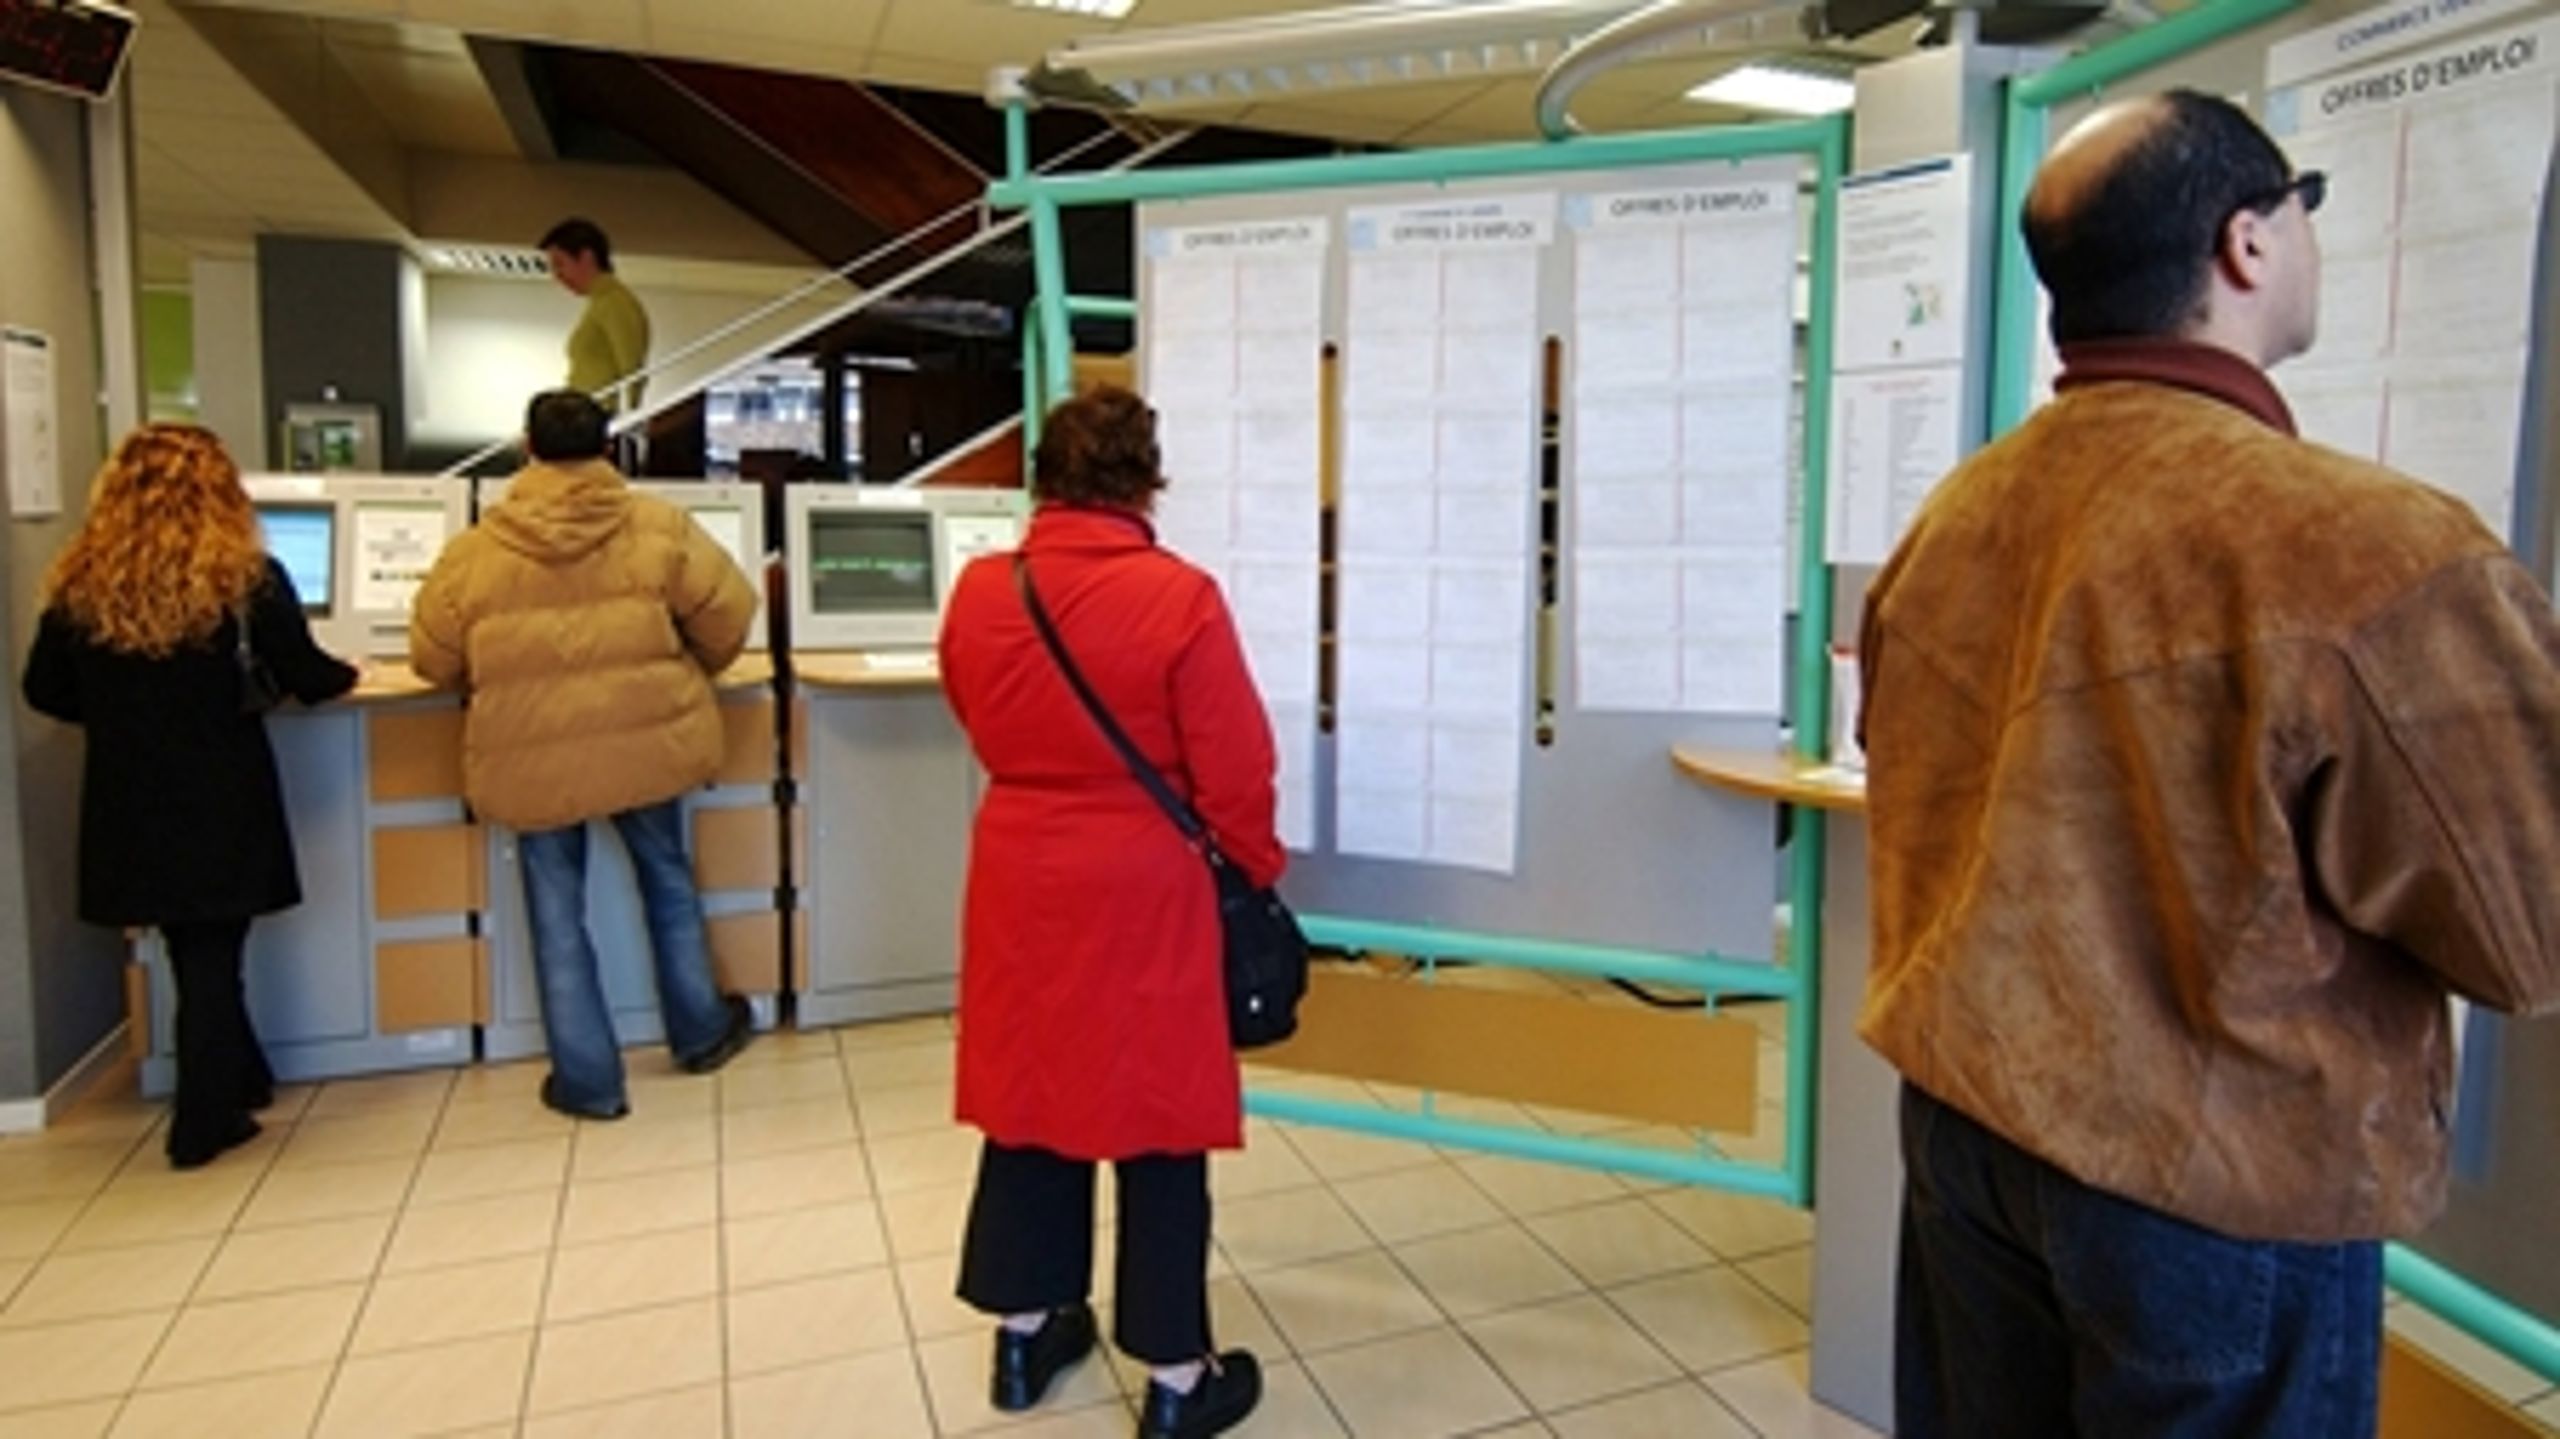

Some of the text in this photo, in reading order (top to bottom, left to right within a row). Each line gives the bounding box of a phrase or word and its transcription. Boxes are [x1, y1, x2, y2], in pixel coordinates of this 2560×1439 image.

[2321, 36, 2539, 114] OFFRES D'EMPLOI
[1609, 189, 1770, 218] OFFRES D'EMPLOI
[1183, 224, 1311, 252] OFFRES D'EMPLOI
[1392, 220, 1534, 245] OFFRES D'EMPLOI
